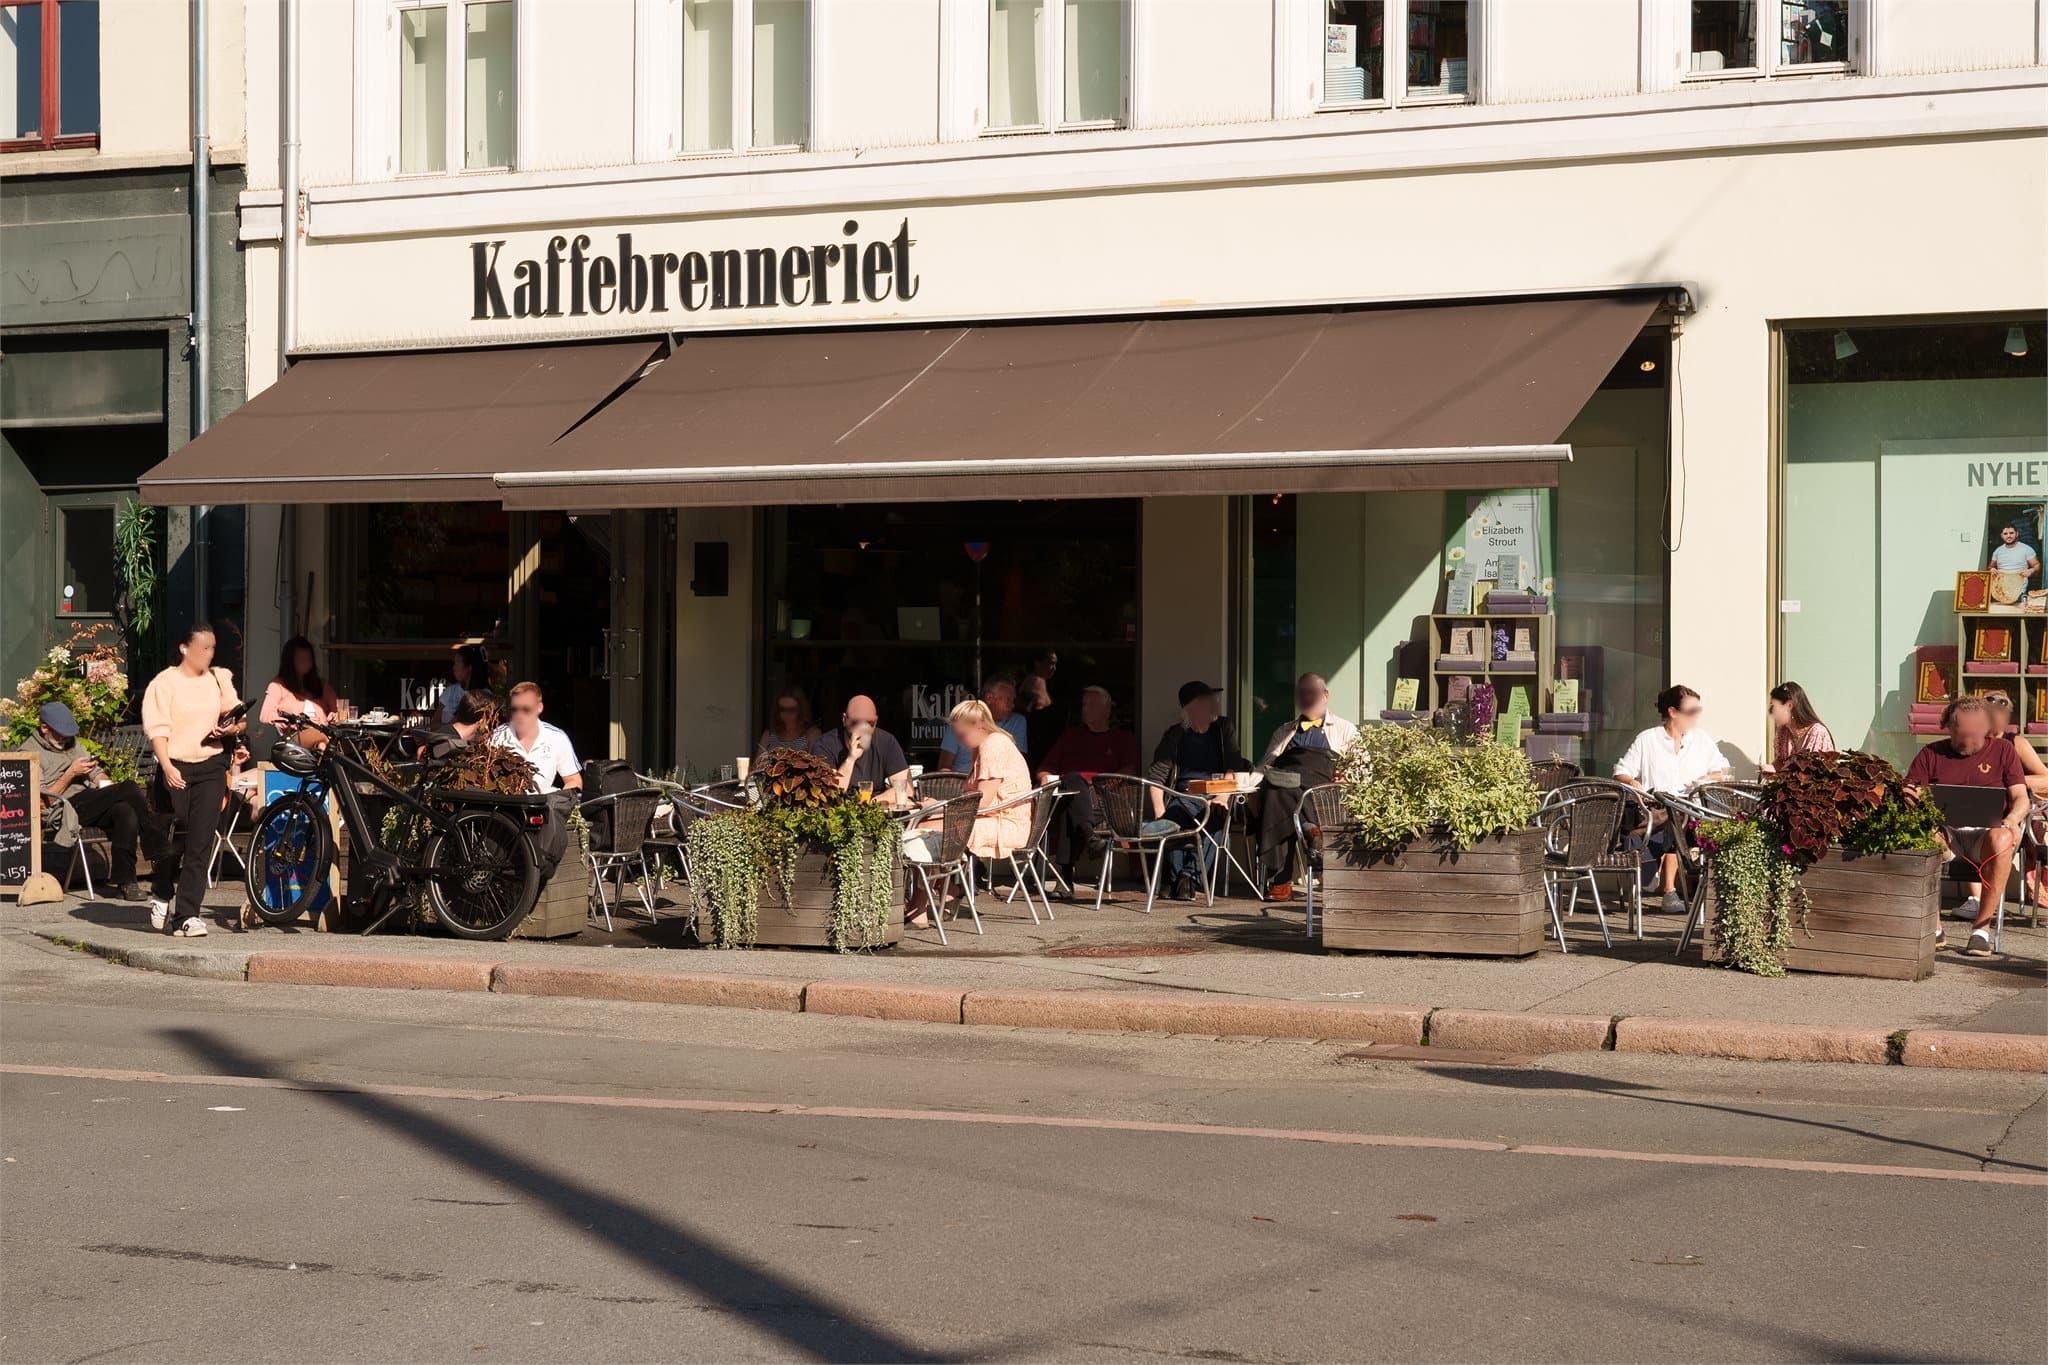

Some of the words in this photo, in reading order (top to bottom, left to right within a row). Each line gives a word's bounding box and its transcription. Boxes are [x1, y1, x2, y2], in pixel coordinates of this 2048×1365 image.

[470, 216, 919, 320] Kaffebrenneriet
[1482, 525, 1524, 535] Elizabeth
[1488, 537, 1517, 547] Strout
